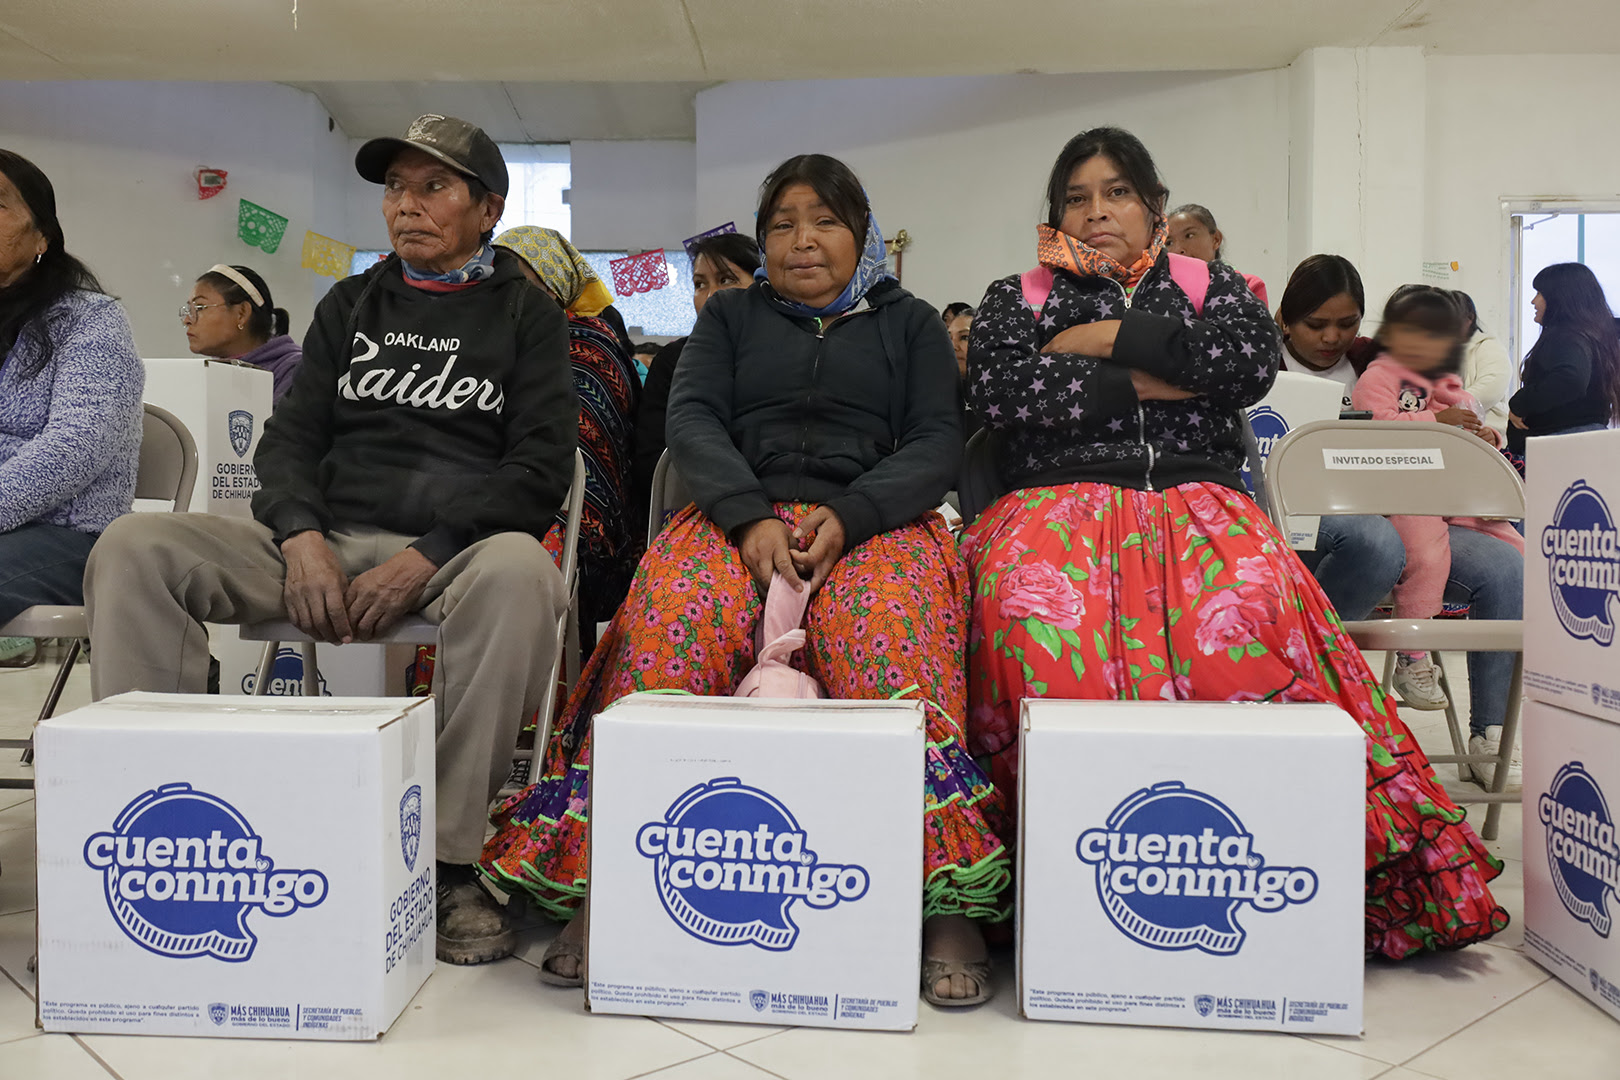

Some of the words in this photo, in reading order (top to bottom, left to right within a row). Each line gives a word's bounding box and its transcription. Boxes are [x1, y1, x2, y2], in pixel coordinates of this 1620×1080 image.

[384, 332, 460, 352] OAKLAND
[217, 463, 255, 475] GOBIERN
[1332, 456, 1384, 464] INVITADO
[1386, 456, 1434, 464] ESPECIAL
[213, 476, 230, 488] DEL
[233, 477, 260, 488] ESTAD
[213, 490, 223, 499] DE
[224, 489, 253, 499] CHIHUA
[1542, 522, 1616, 559] cuenta
[1554, 558, 1620, 592] conmi
[639, 823, 803, 862] cuenta
[1540, 796, 1615, 855] cuenta
[87, 830, 258, 869] cuenta
[1080, 828, 1249, 865] cuenta
[1552, 831, 1620, 890] conmi
[119, 869, 325, 914] conmigo
[390, 866, 430, 922] GOBIERNO
[668, 859, 866, 907] conmigo
[1110, 865, 1315, 910] conmigo
[386, 921, 403, 953] DEL
[405, 886, 434, 932] ESTADO
[386, 951, 396, 974] DE
[398, 908, 434, 960] CHIHUAHUA
[231, 1004, 246, 1016] MÁS
[248, 1006, 290, 1017] CHIHUAHUA
[771, 992, 786, 1003] MÁS
[788, 994, 828, 1006] CHIHUAHUA
[1217, 997, 1232, 1008] MÁS
[1234, 998, 1276, 1010] CHIHUAHUA
